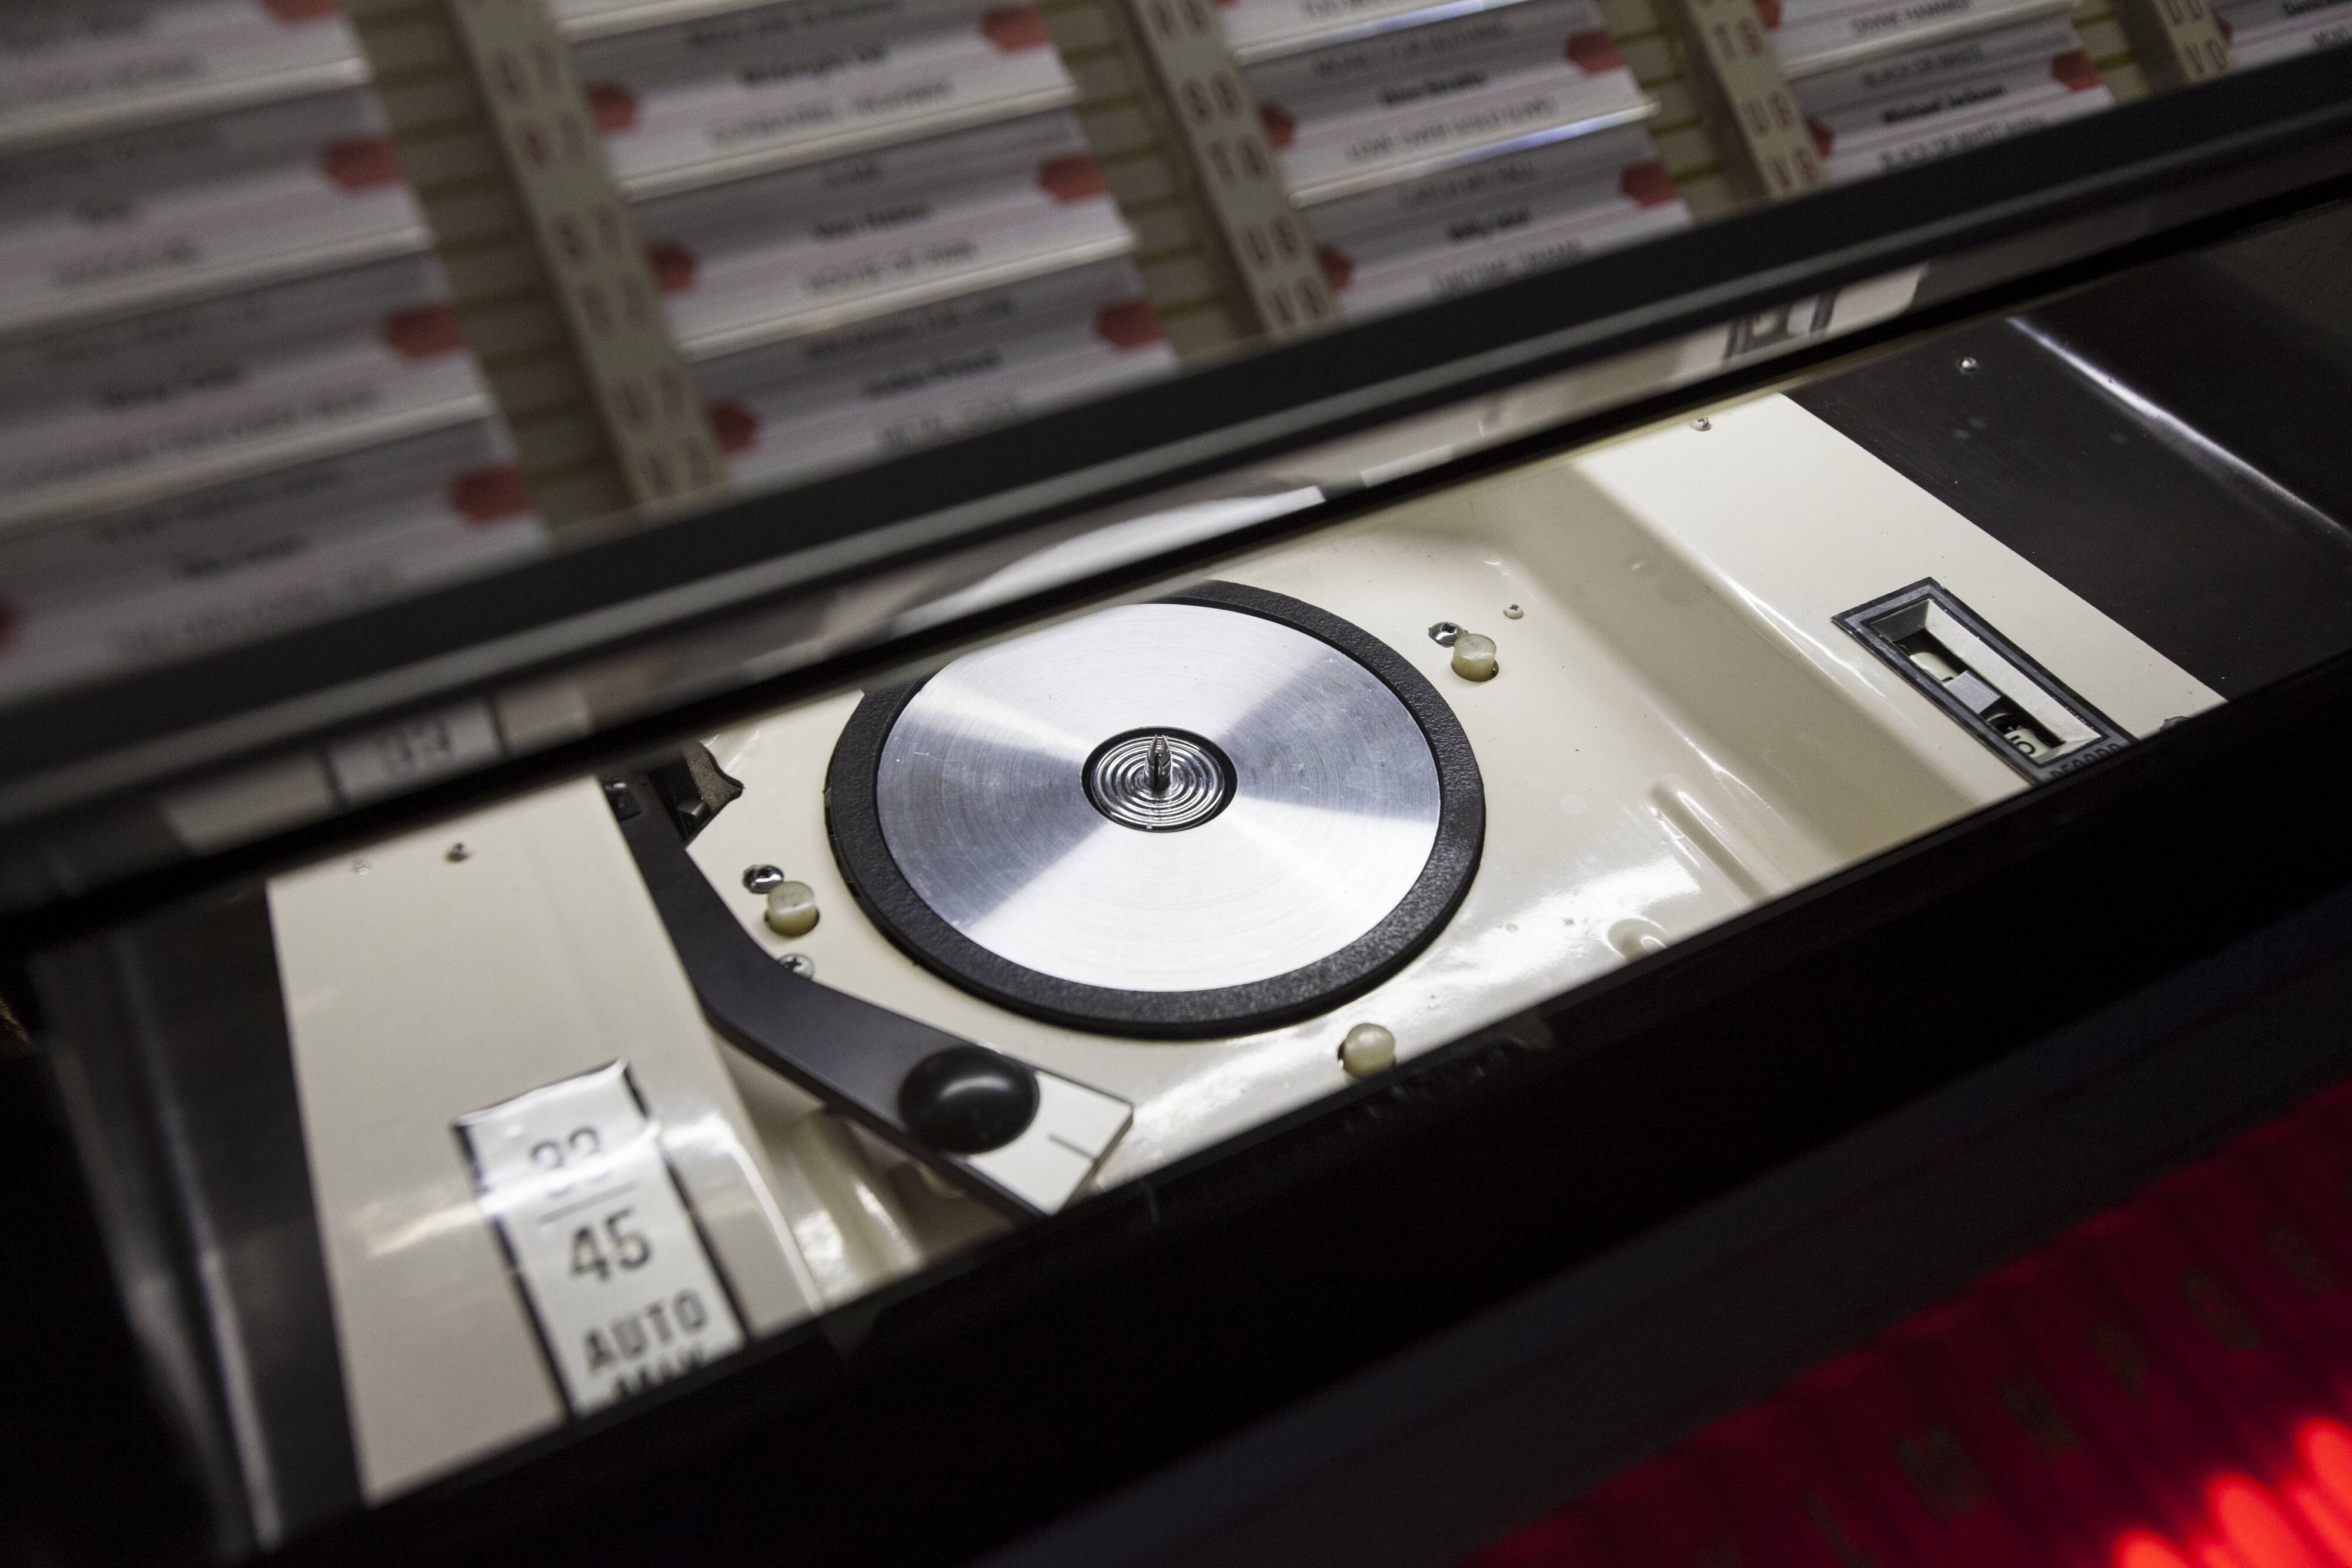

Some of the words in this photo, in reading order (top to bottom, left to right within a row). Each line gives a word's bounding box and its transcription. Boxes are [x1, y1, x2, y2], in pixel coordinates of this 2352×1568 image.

[1882, 99, 1941, 125] Michael
[1946, 86, 2007, 109] Jackson
[567, 1205, 653, 1284] 45
[583, 1289, 709, 1376] AUTO
